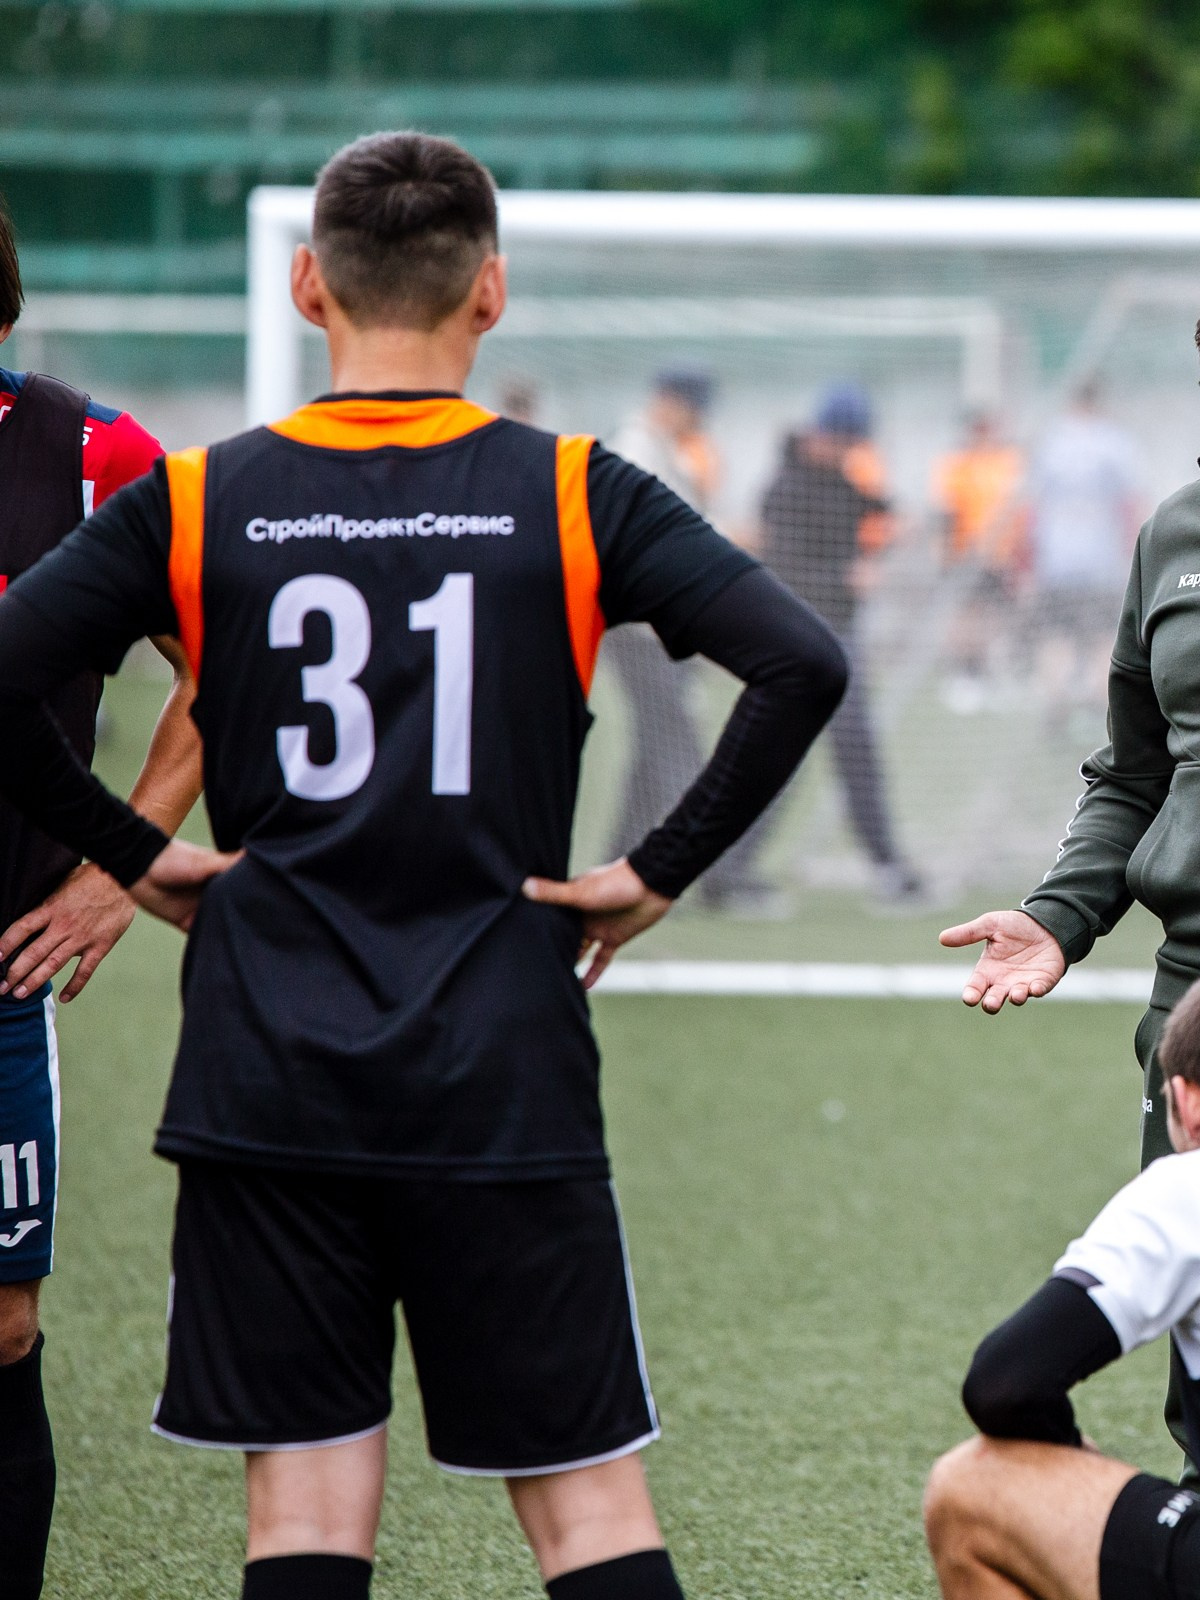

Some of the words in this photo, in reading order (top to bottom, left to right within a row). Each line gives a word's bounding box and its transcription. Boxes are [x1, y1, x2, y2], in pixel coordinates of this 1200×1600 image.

[246, 512, 515, 544] СтройПроектСервис
[267, 572, 474, 801] 31
[0, 1140, 40, 1209] 11
